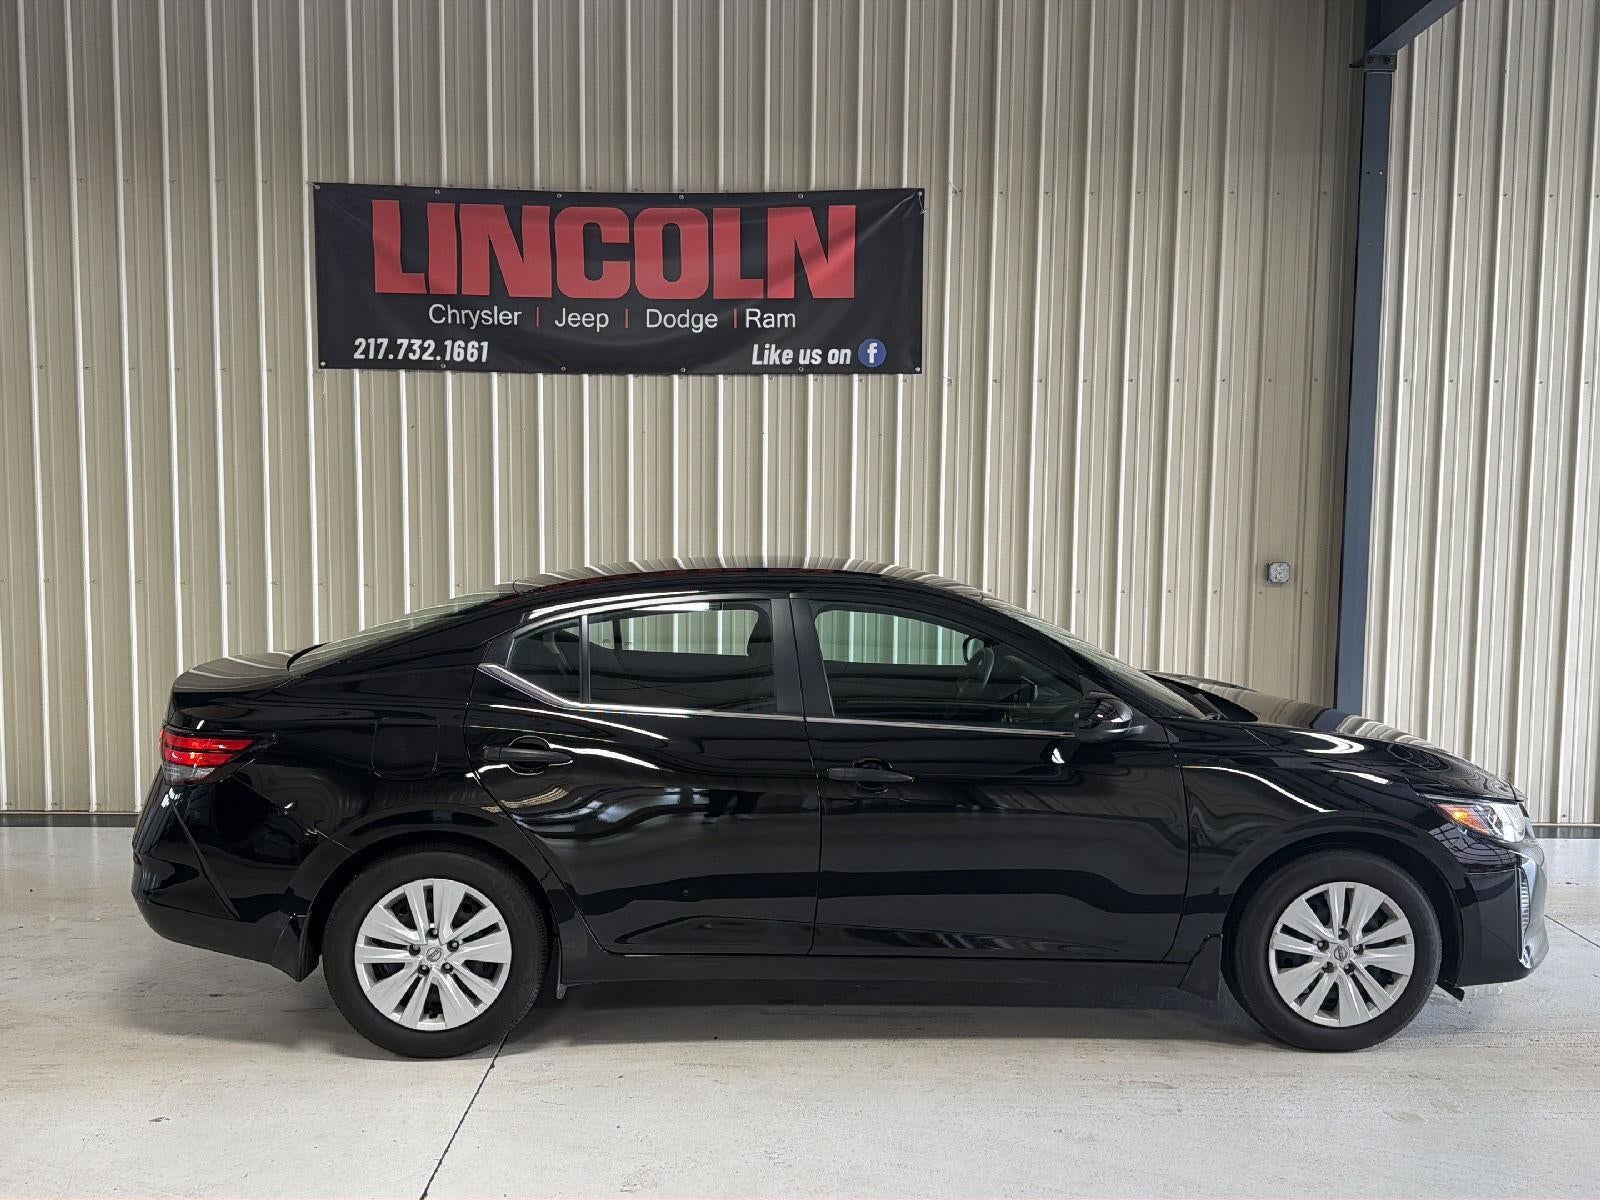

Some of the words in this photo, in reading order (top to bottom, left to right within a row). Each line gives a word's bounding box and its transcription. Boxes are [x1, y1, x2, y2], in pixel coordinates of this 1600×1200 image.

[371, 199, 856, 300] LINCOLN
[428, 303, 522, 330] Chrysler
[554, 307, 610, 333] Jeep
[646, 308, 719, 333] Dodge
[745, 308, 796, 329] Ram
[353, 337, 489, 363] 217.732.1661
[751, 343, 794, 366] Like
[798, 348, 823, 365] us
[827, 348, 852, 365] on
